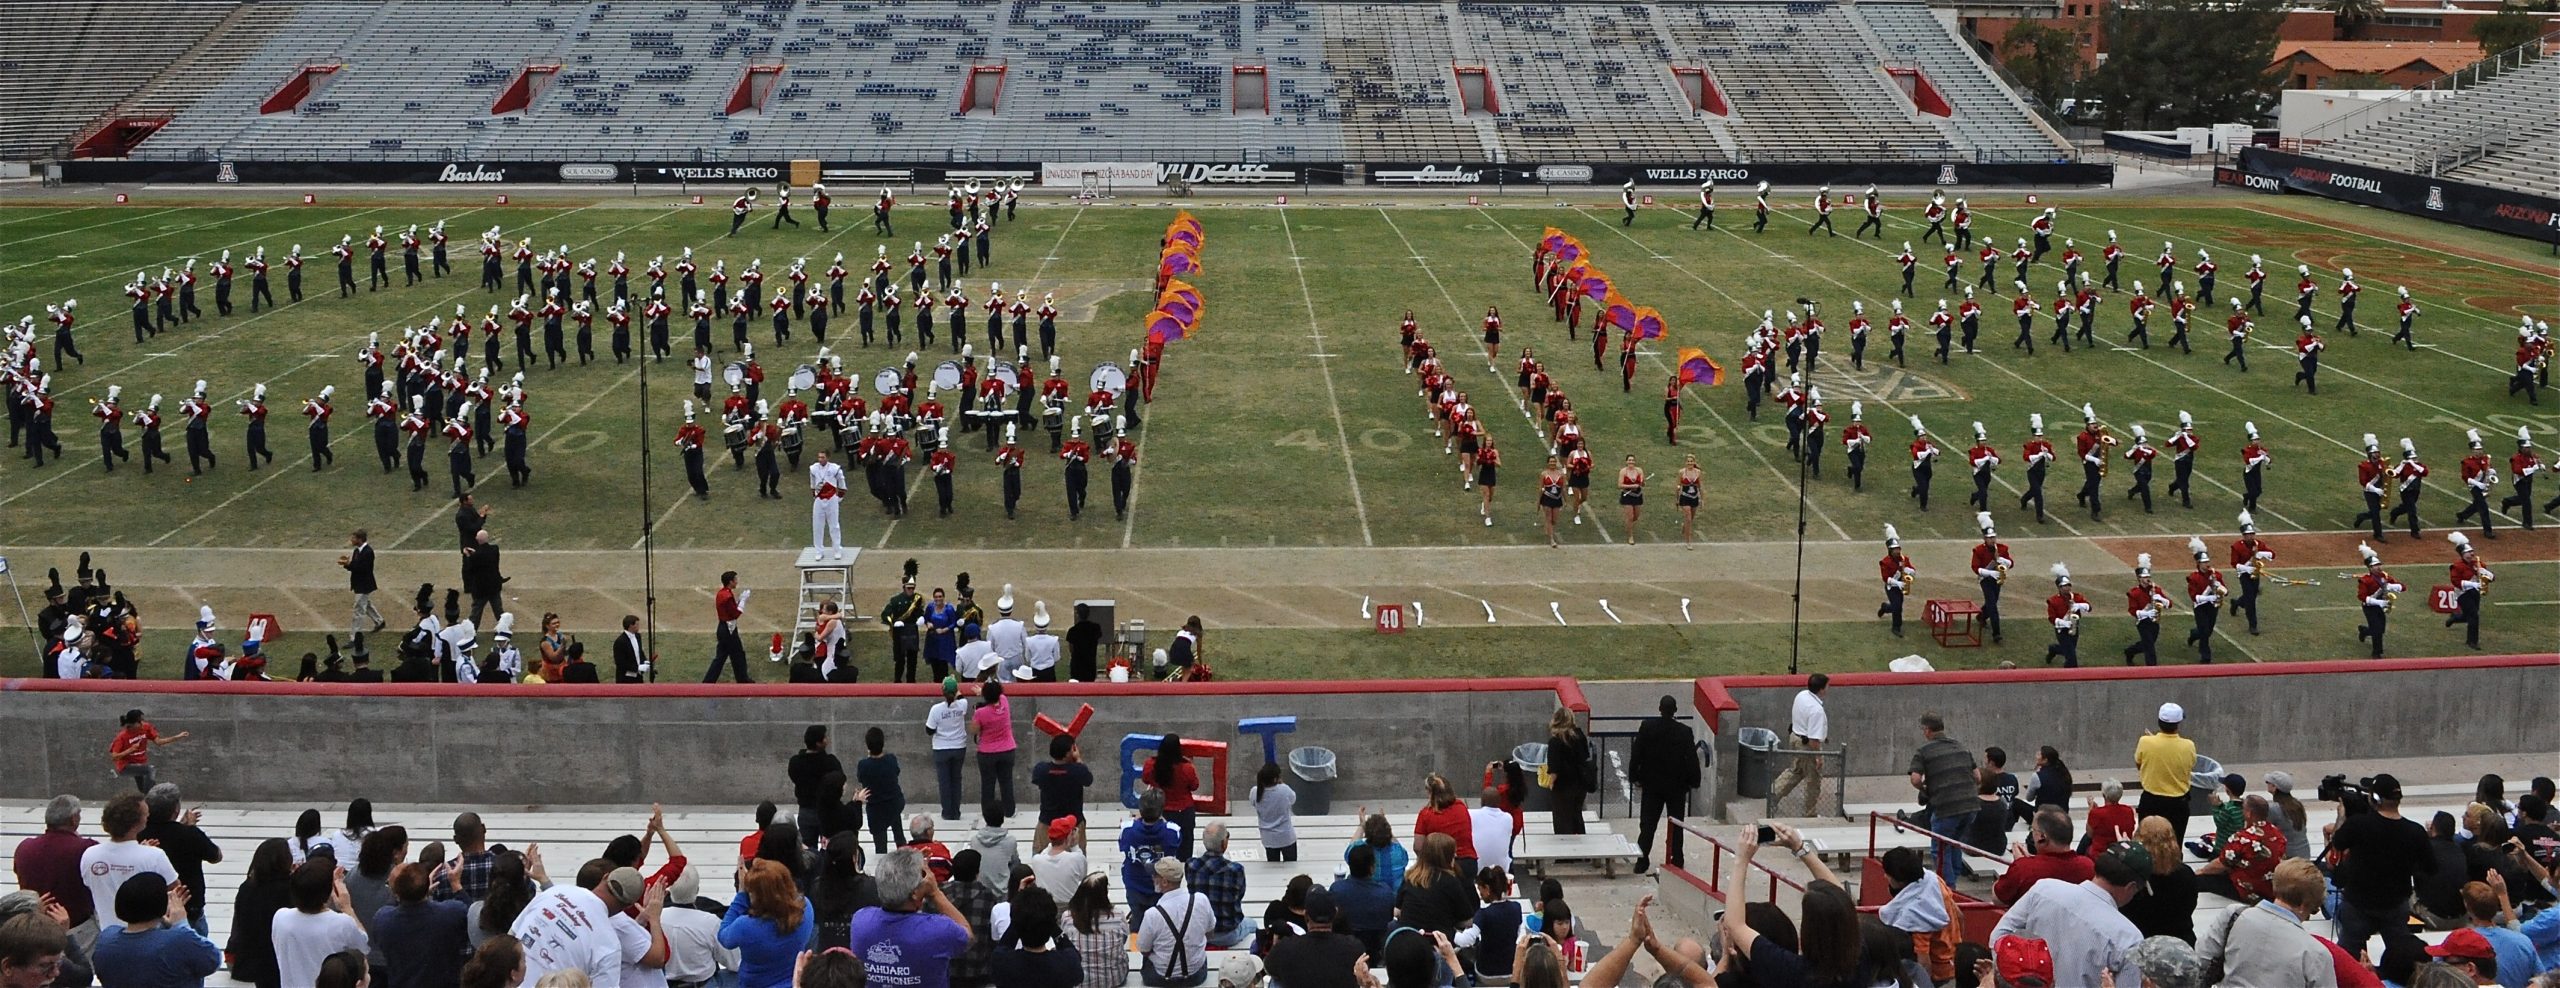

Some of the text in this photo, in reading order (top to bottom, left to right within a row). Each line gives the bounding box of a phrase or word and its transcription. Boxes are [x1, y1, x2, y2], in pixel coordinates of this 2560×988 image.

[439, 163, 505, 182] Bashas'
[672, 167, 778, 179] WELLS FARGO
[1045, 168, 1080, 179] UNIVERSITY
[1121, 169, 1140, 179] BAND
[1141, 169, 1154, 179] DAY
[1646, 169, 1749, 180] WELLS FARGO
[1937, 165, 1957, 184] A
[2245, 174, 2279, 191] DOWN
[2329, 173, 2382, 194] FOOTBALL
[2426, 186, 2444, 211] A
[2495, 203, 2551, 225] ARIZONA
[2438, 590, 2458, 609] 20
[1380, 609, 1399, 629] 40
[863, 962, 910, 976] SAHUARO
